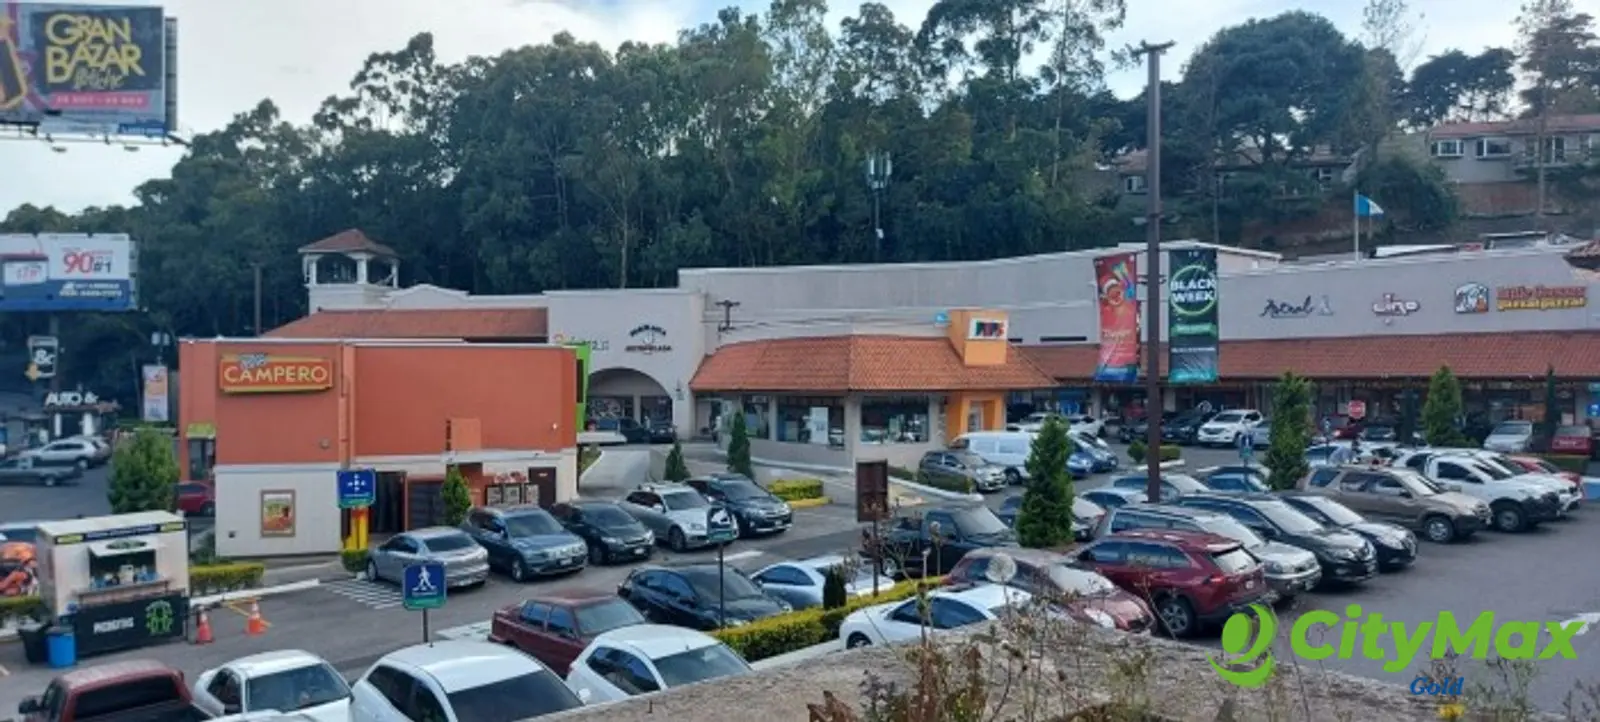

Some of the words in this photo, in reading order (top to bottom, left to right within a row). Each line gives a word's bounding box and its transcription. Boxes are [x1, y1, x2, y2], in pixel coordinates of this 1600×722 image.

[45, 13, 131, 46] GRAN
[46, 43, 146, 84] BAZAR
[63, 251, 93, 273] 90
[1170, 278, 1216, 291] BLACK
[1171, 290, 1214, 303] WEEK
[223, 365, 328, 383] CAMPERO
